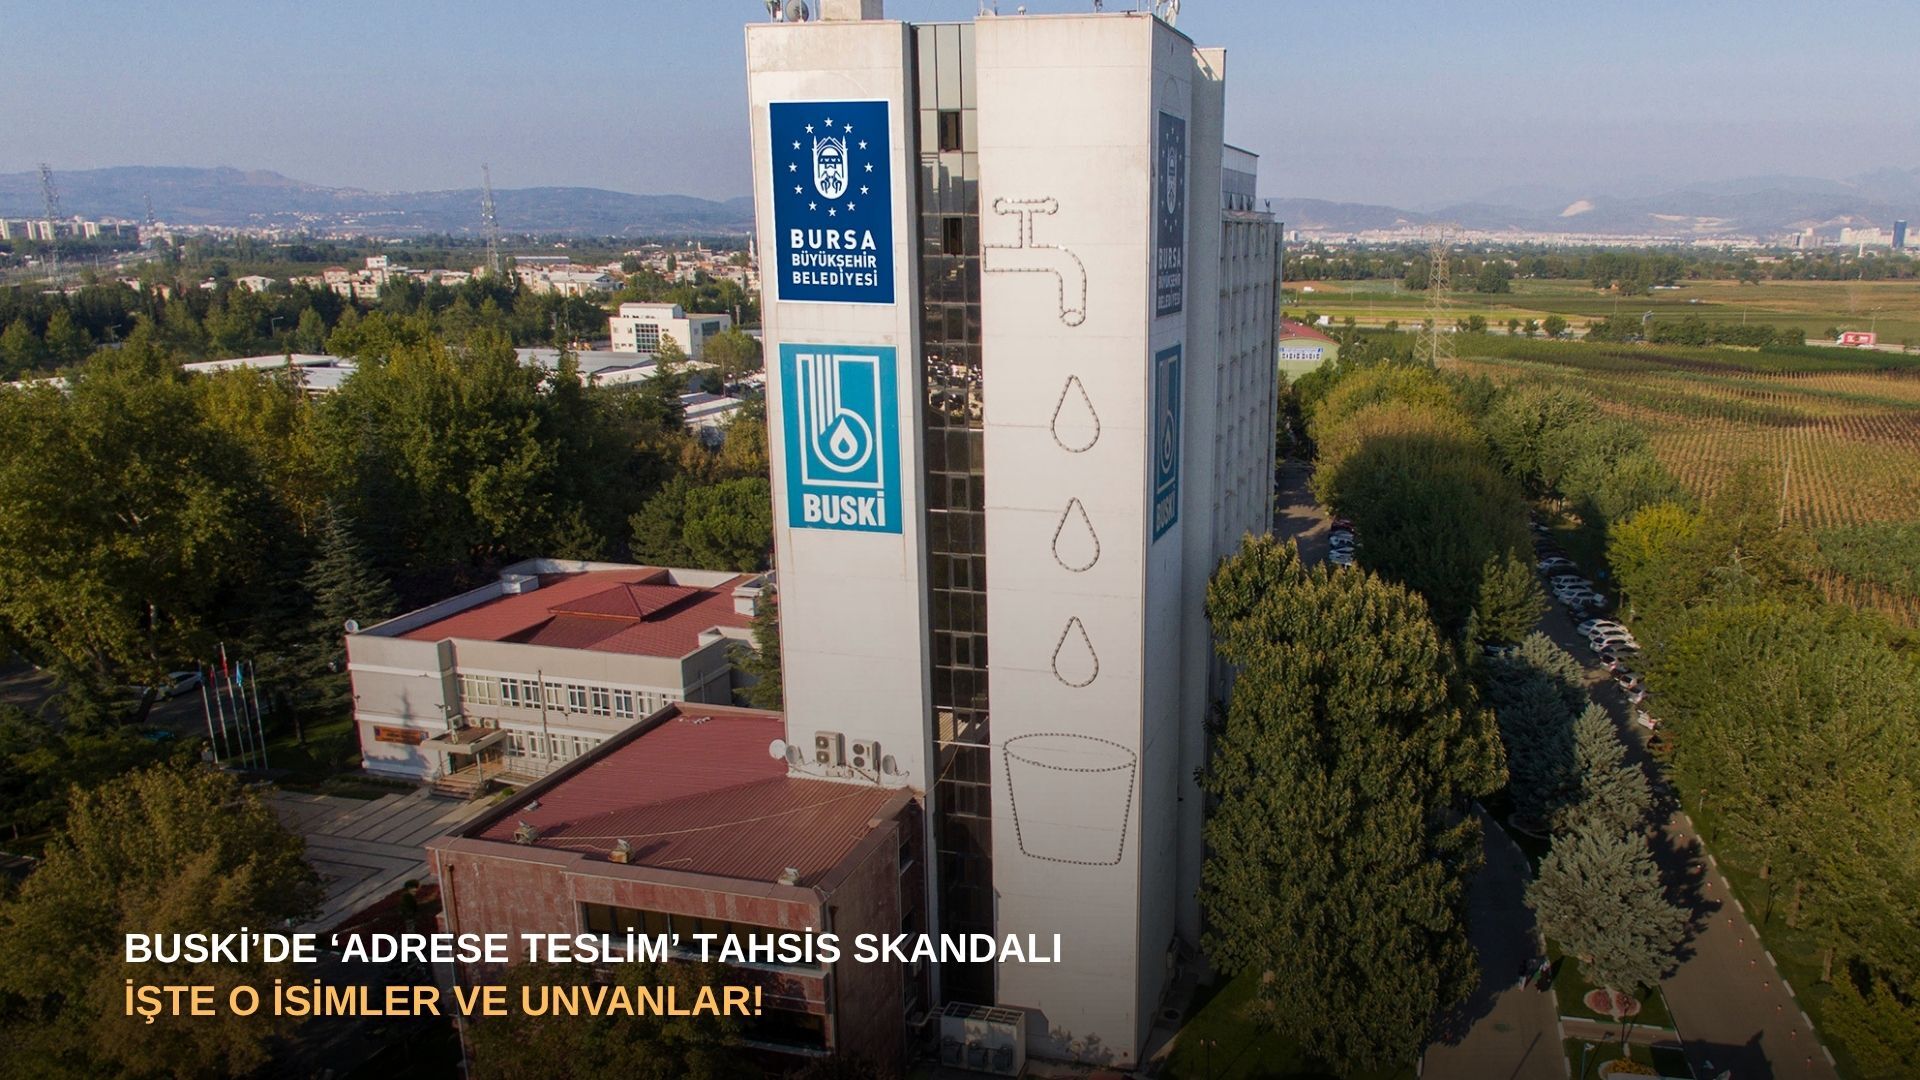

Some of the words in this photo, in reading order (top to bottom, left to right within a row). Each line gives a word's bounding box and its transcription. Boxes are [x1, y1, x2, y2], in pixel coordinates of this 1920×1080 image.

[790, 228, 877, 250] BURSA
[791, 250, 877, 270] BÜYÜKŞEHİR
[1159, 247, 1181, 270] BURSA
[792, 269, 879, 287] BELEDİYESİ
[803, 491, 886, 527] BUSKİ
